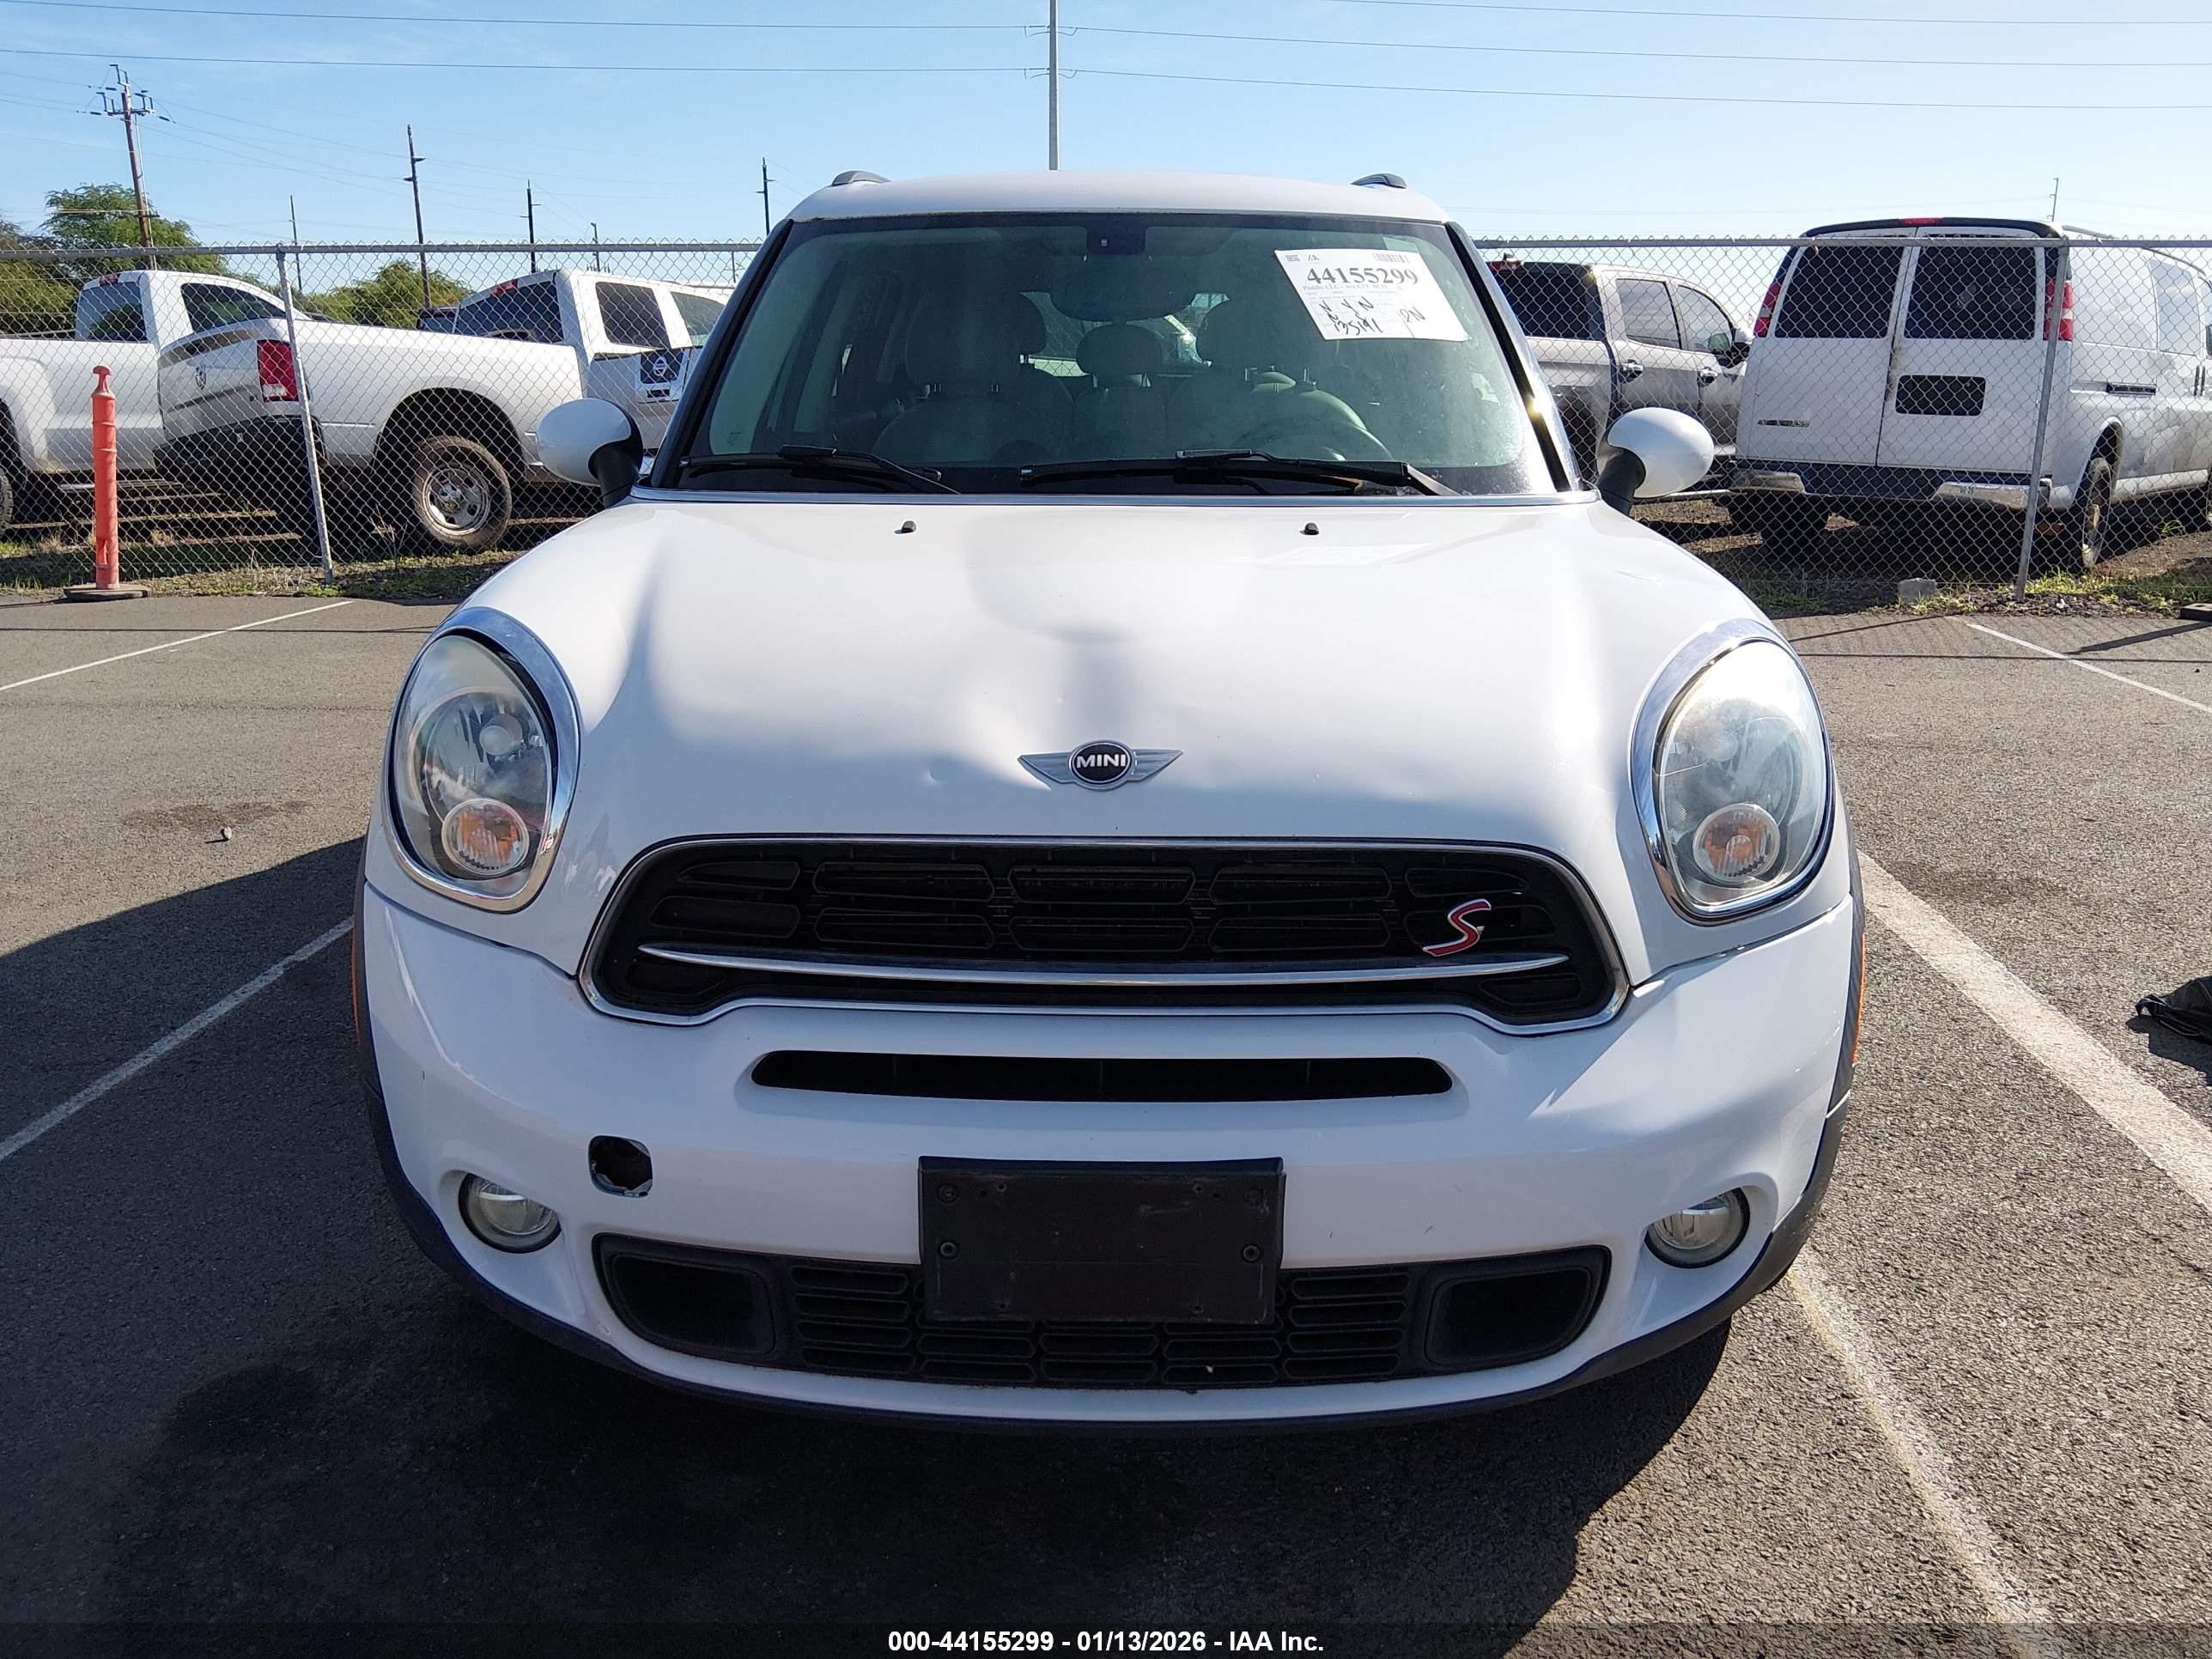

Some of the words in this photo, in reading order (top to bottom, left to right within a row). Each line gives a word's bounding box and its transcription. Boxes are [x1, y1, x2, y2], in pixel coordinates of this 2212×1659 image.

[1307, 267, 1419, 285] 44155299
[1076, 754, 1127, 769] MINI
[1422, 898, 1492, 957] S
